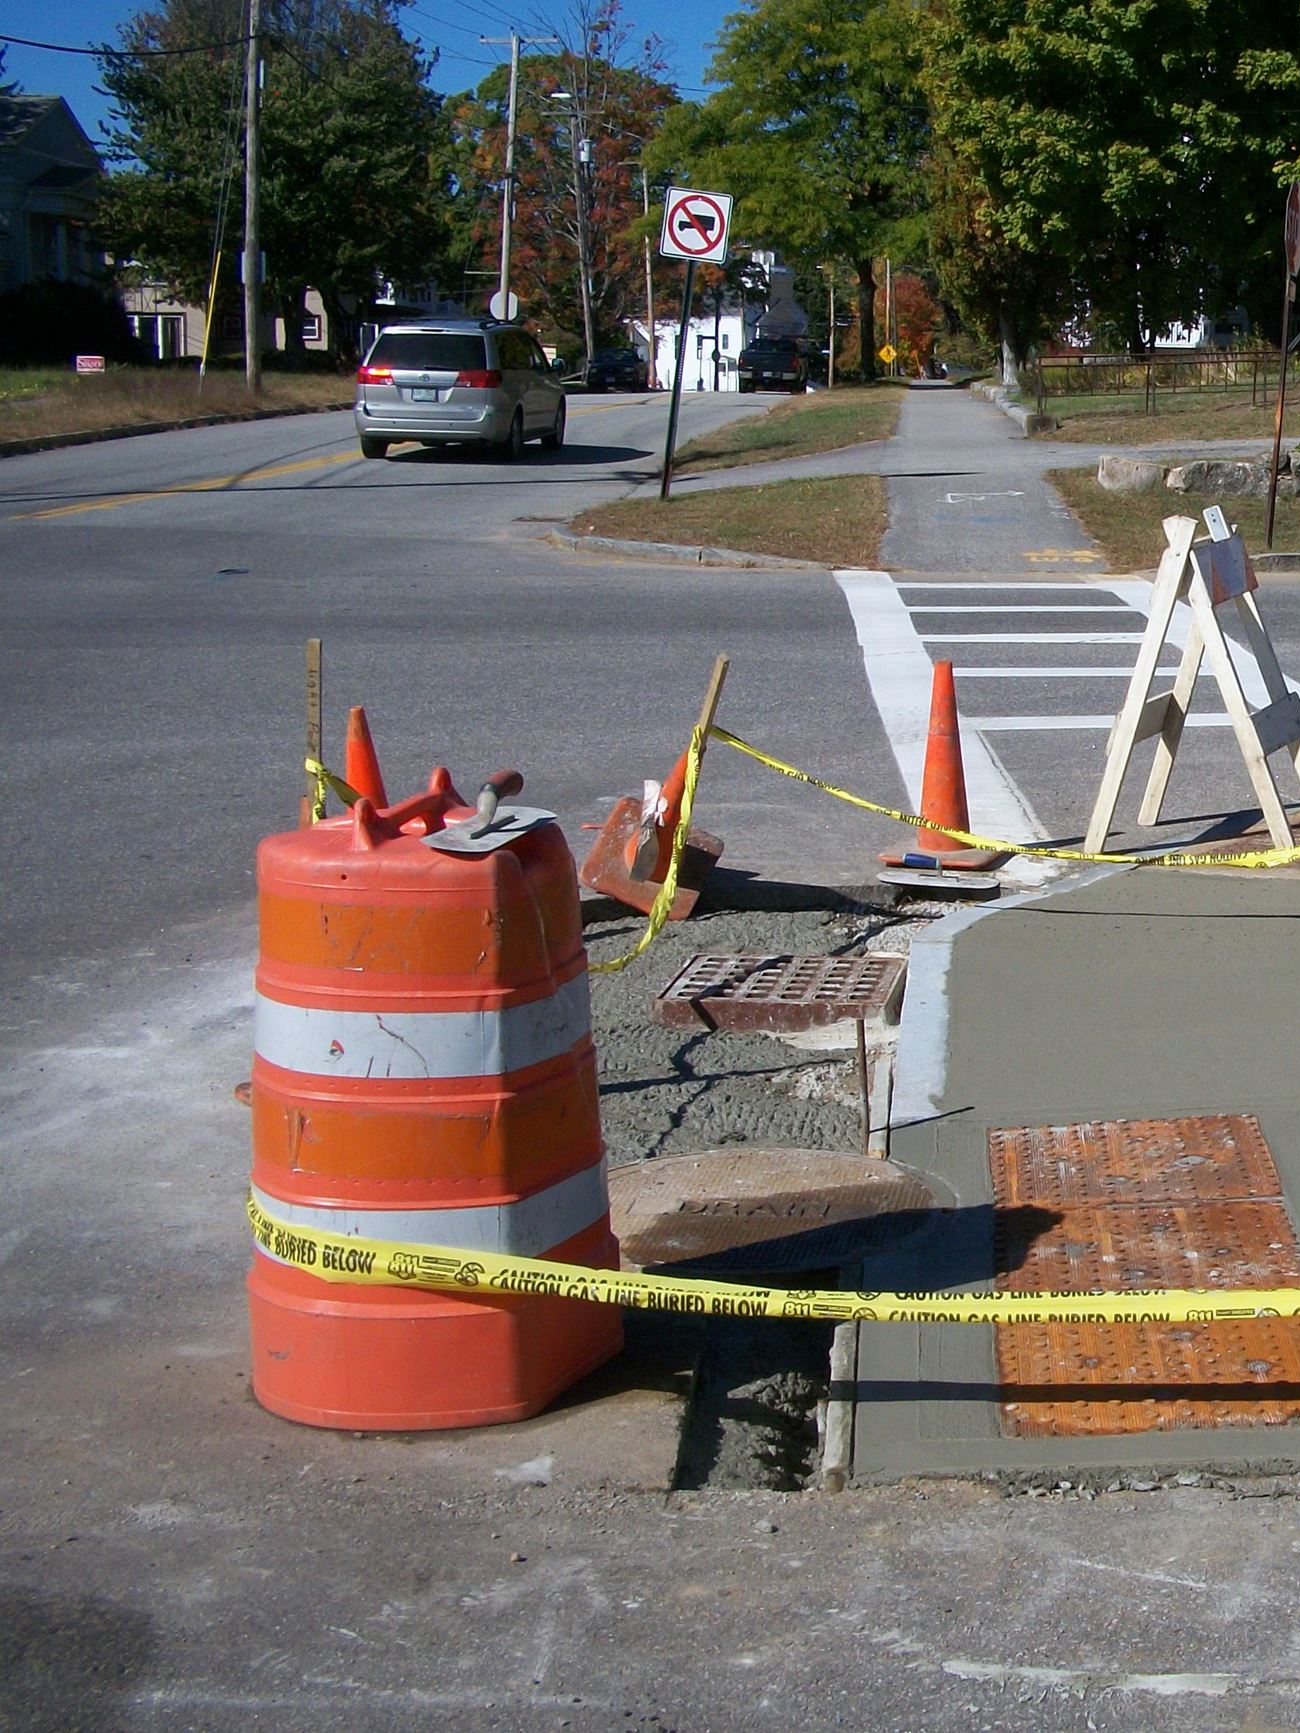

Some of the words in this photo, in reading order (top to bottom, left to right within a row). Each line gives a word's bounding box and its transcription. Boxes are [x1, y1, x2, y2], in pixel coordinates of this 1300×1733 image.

[677, 1199, 830, 1218] DRAIN
[275, 1237, 318, 1266] BURIED
[322, 1246, 377, 1275] BELOW
[490, 1276, 560, 1297] CAUTION
[567, 1284, 599, 1302] GAS
[607, 1287, 640, 1307] LINE
[648, 1293, 705, 1313] BURIED
[712, 1297, 768, 1316] BELOW
[783, 1301, 811, 1317] 811
[889, 1309, 960, 1323] CAUTION
